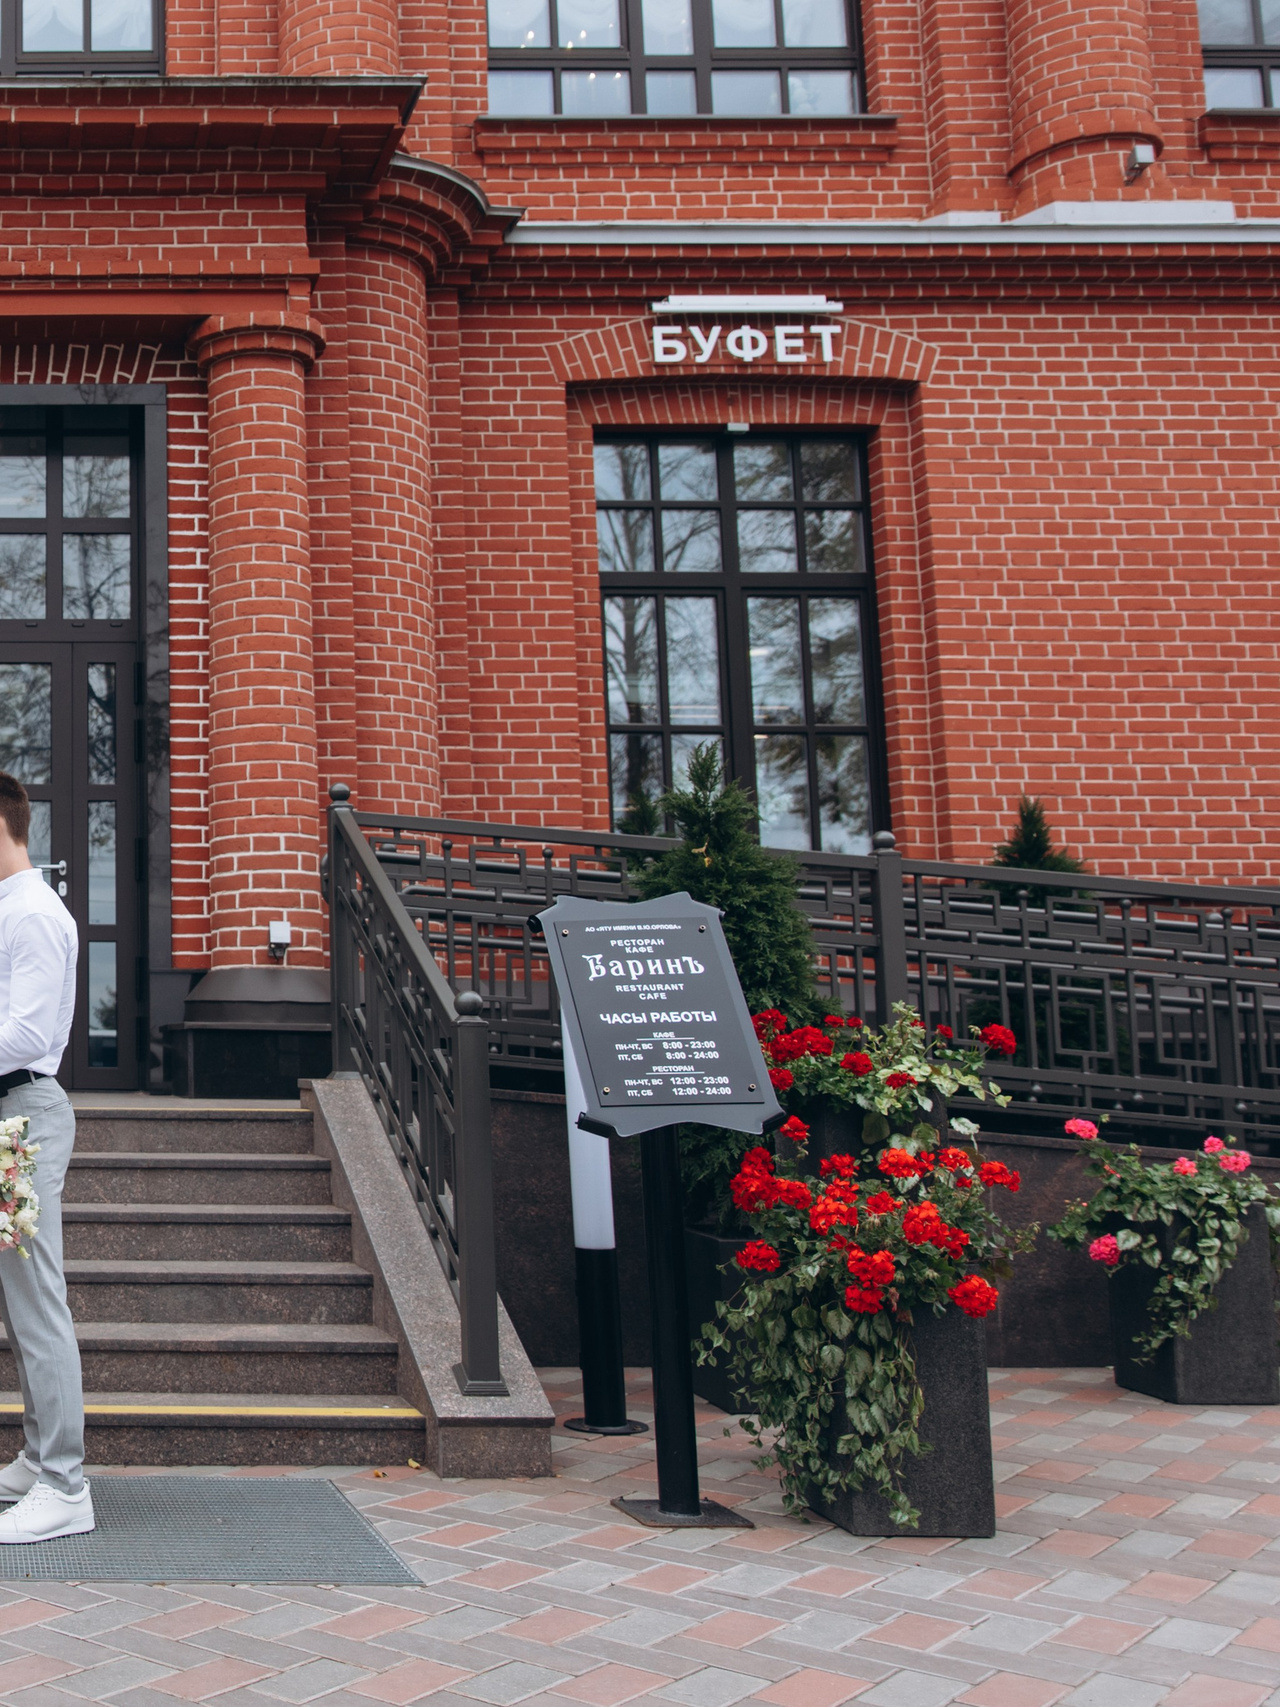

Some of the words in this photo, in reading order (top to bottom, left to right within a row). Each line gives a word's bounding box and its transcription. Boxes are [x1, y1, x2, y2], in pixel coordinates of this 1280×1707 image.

[652, 325, 842, 363] БУФЕТ
[610, 938, 665, 947] РЕСТОРАН
[615, 983, 684, 992] RESTAURANT
[639, 992, 667, 1000] CAFE
[600, 1012, 647, 1024] ЧАСЫ
[650, 1010, 717, 1023] РАБОТЫ
[615, 1043, 641, 1051] ПН-ЧТ,
[662, 1041, 683, 1049] 8:00
[690, 1040, 716, 1049] 23:00
[665, 1052, 686, 1060] 8:00
[693, 1051, 719, 1059] 24:00
[670, 1077, 696, 1085] 12:00
[703, 1076, 729, 1084] 23:00
[627, 1089, 640, 1097] ПТ,
[672, 1087, 698, 1095] 12:00
[705, 1086, 732, 1095] 24:00
